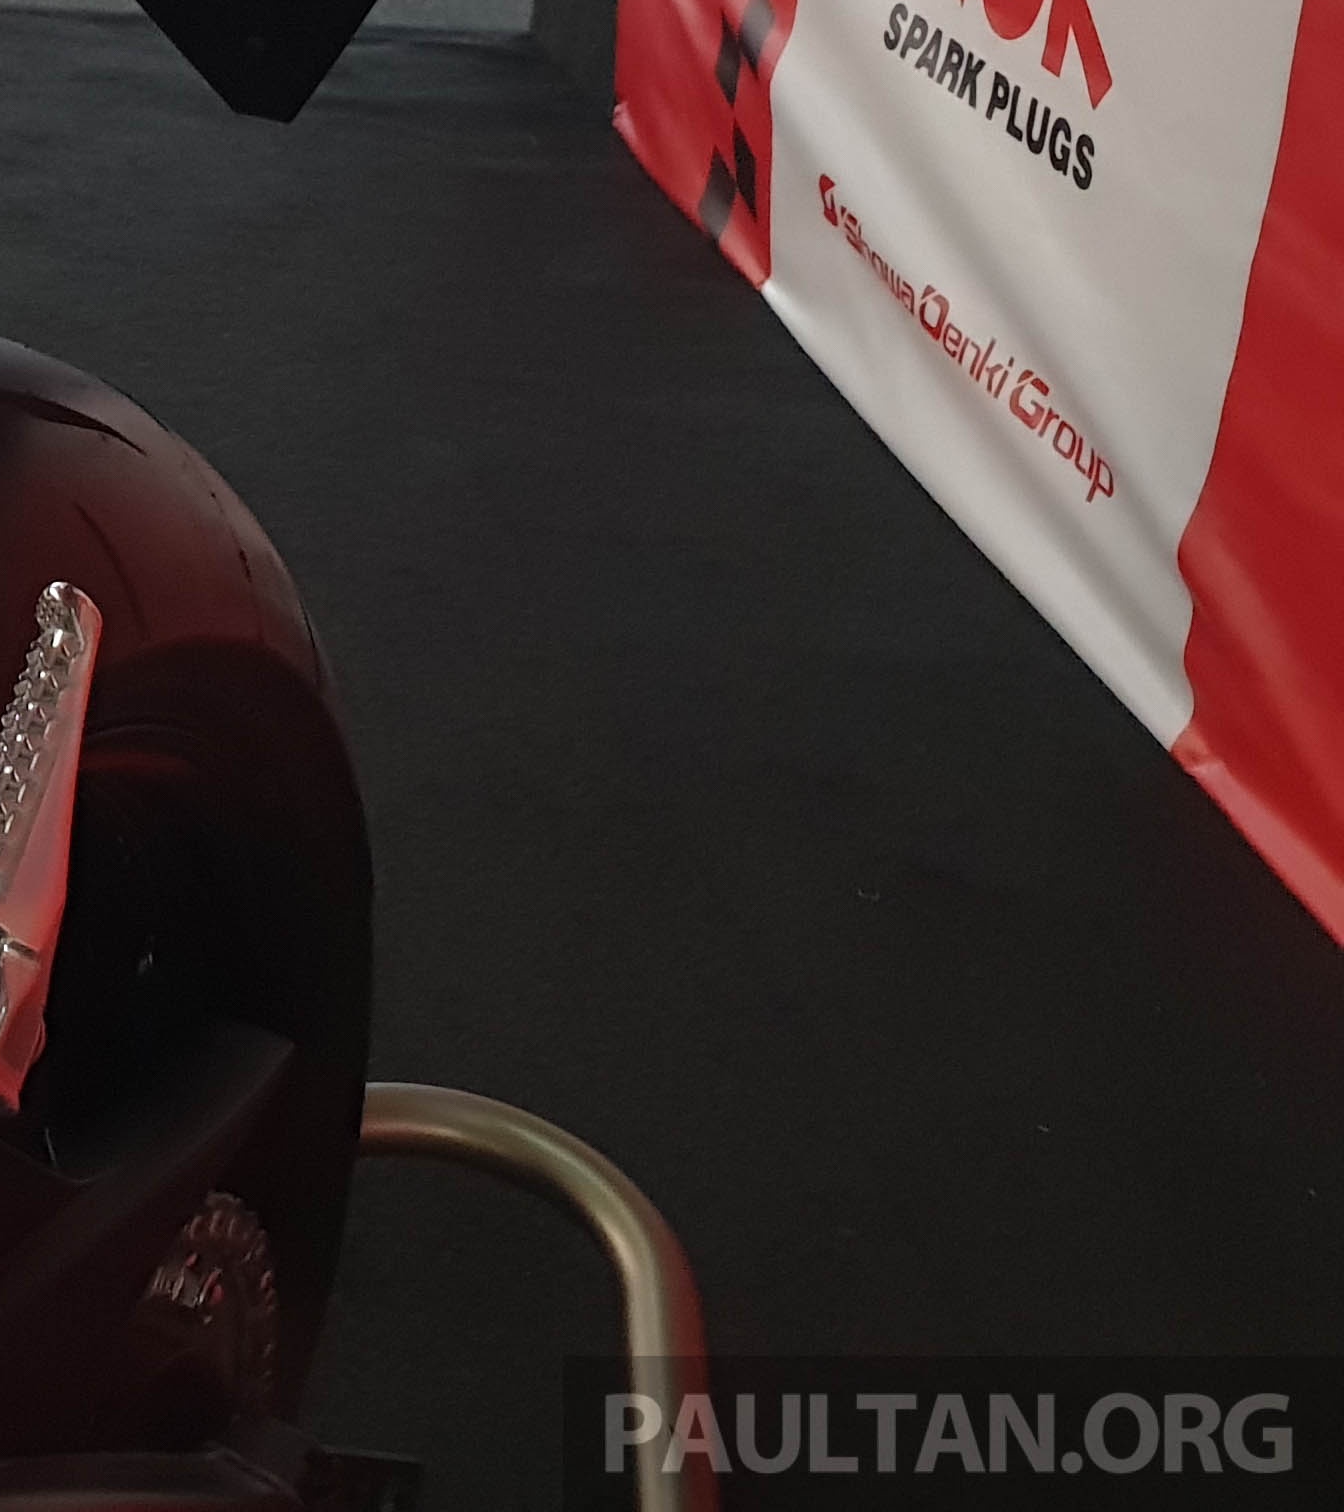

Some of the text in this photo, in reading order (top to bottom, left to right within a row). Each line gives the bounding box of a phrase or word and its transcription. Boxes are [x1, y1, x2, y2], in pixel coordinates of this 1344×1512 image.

[883, 2, 1095, 190] SPARK PLUGS
[1009, 368, 1115, 503] Group
